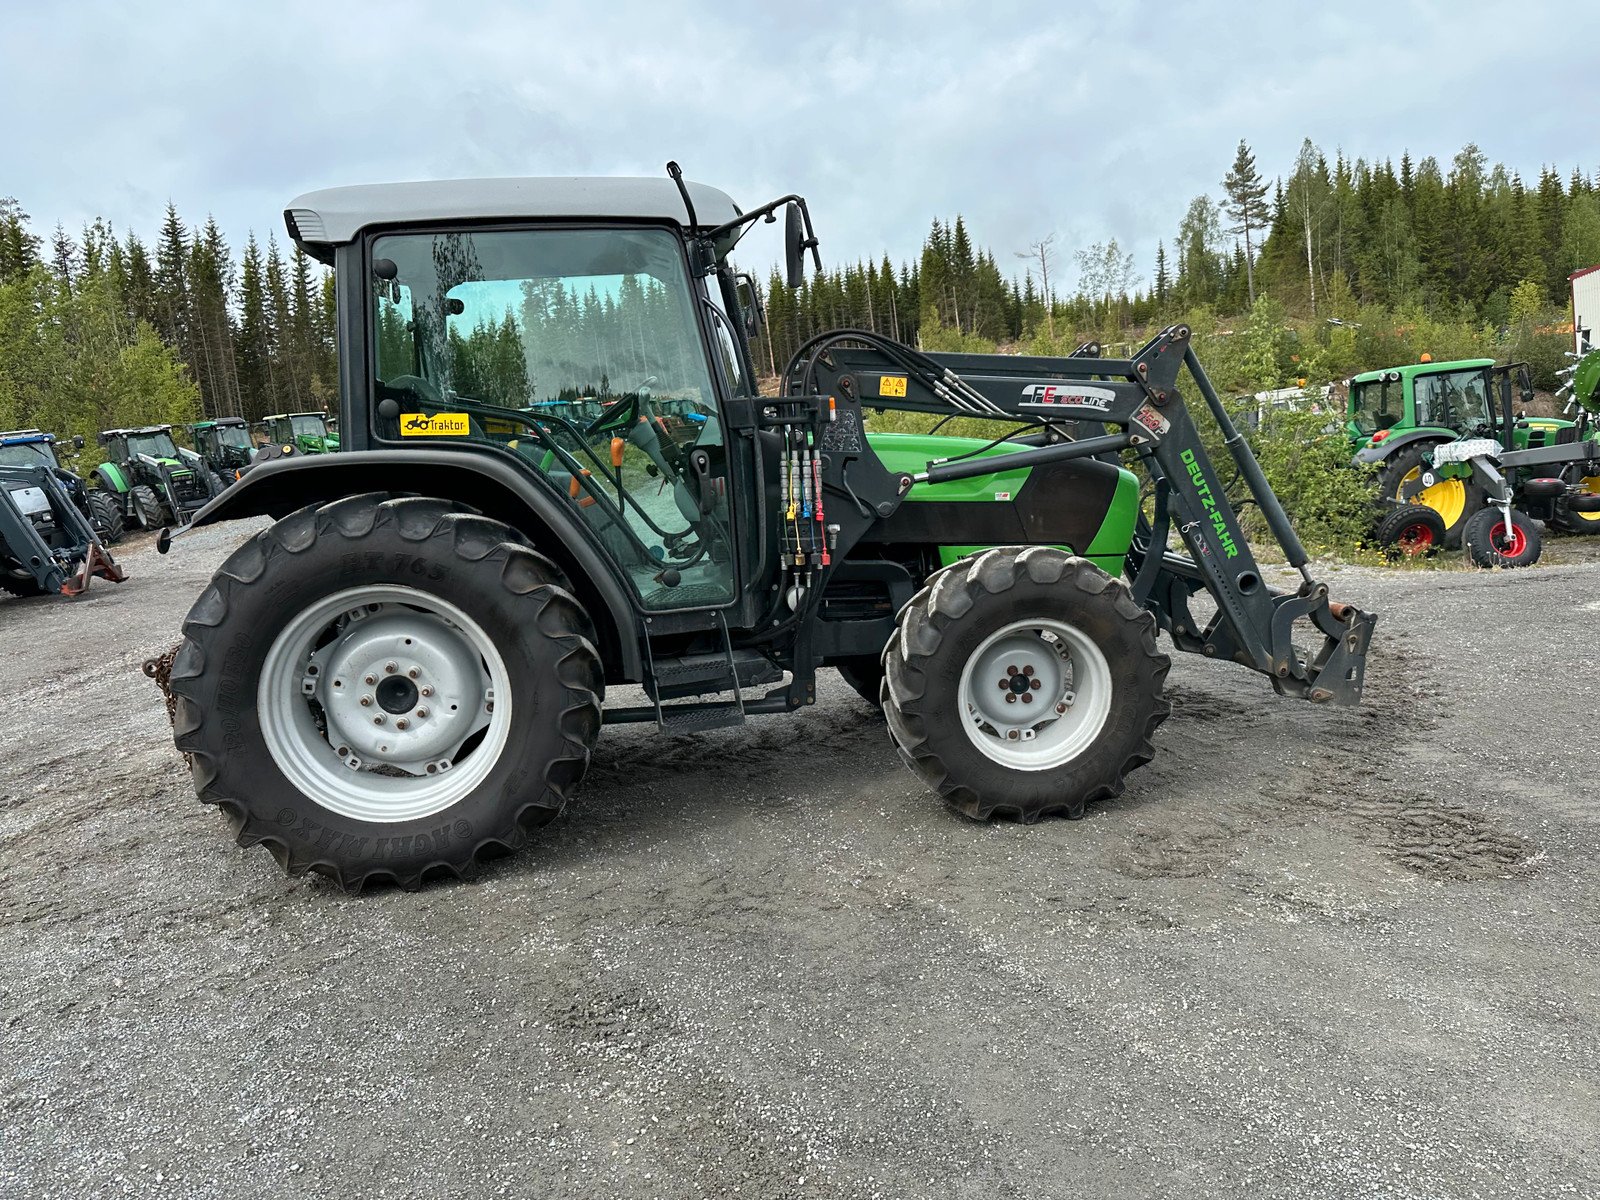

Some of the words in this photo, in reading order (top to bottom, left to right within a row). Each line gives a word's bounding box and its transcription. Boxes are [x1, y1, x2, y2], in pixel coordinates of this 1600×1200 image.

[1031, 386, 1057, 404] FE
[430, 419, 464, 431] Traktor
[1180, 448, 1239, 560] DEUTZ-FAHR
